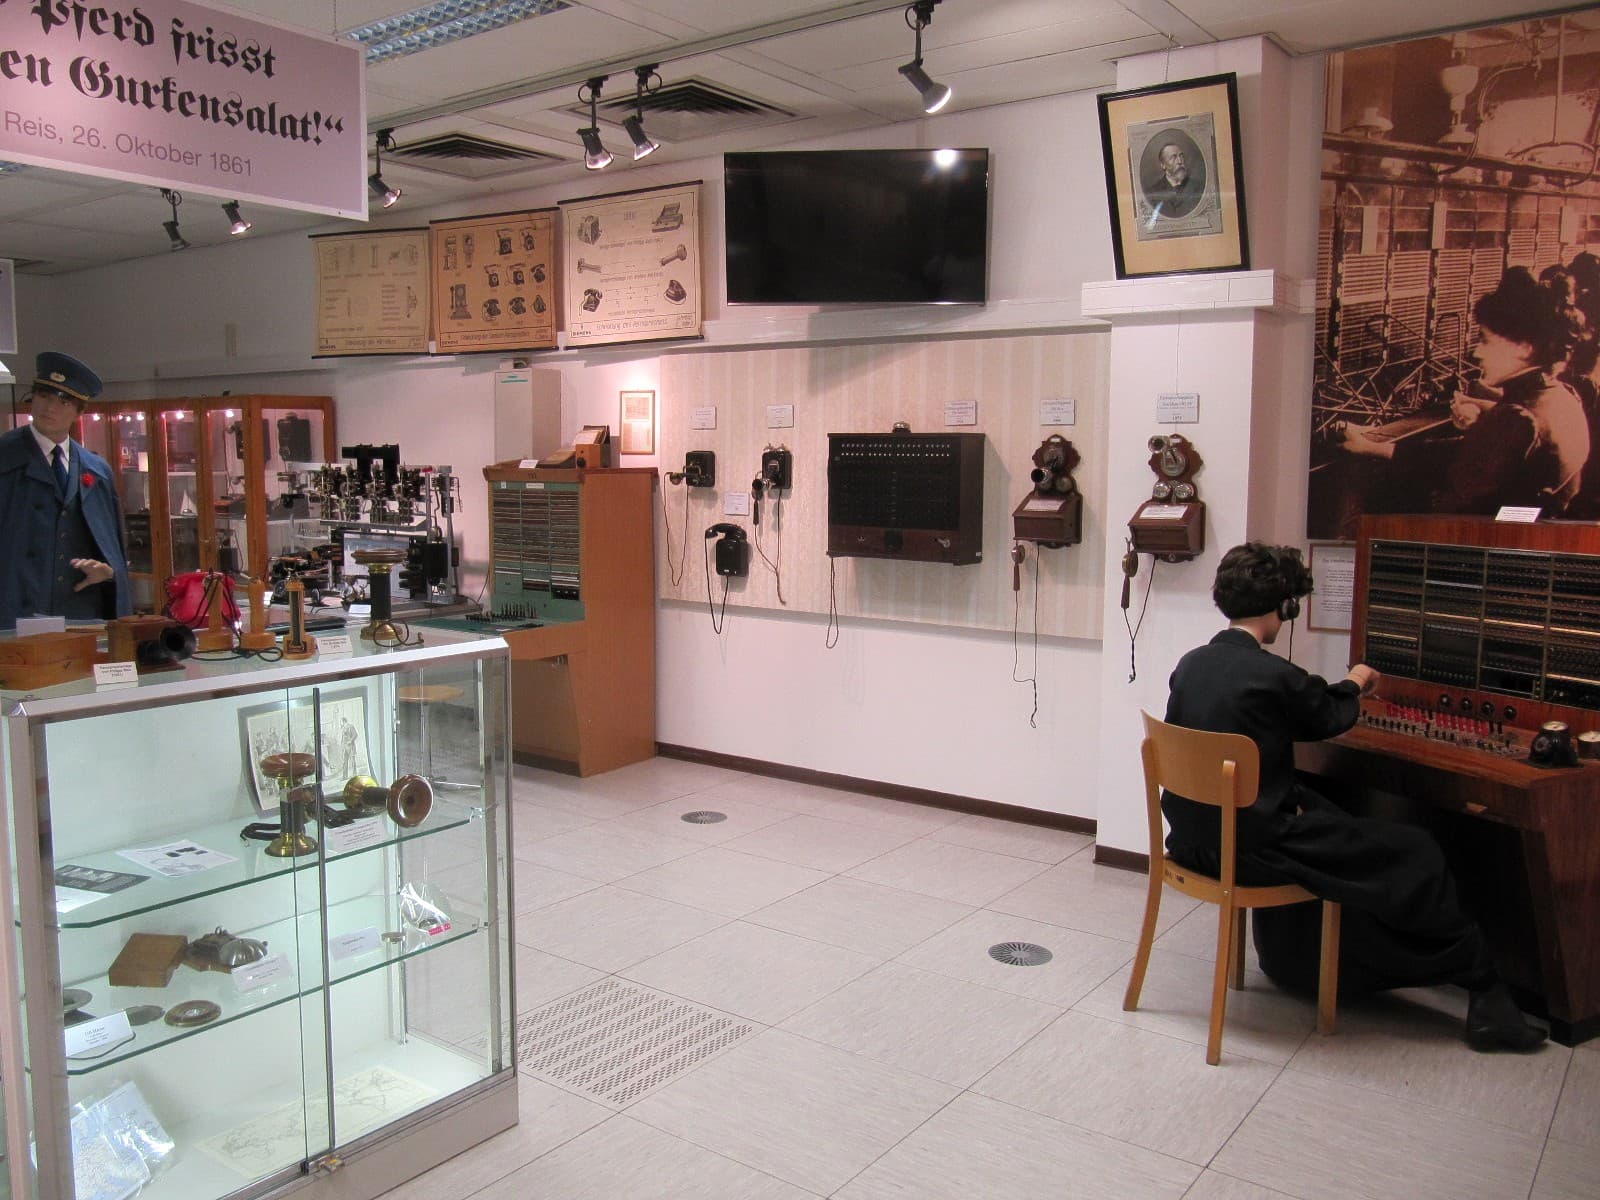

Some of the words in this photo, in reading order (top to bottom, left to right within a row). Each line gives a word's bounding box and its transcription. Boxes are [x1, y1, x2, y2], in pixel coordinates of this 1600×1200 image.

[171, 17, 276, 79] frisst
[5, 111, 63, 145] Reis,
[72, 124, 106, 150] 26.
[115, 133, 201, 168] Oktober
[209, 151, 252, 177] 1861
